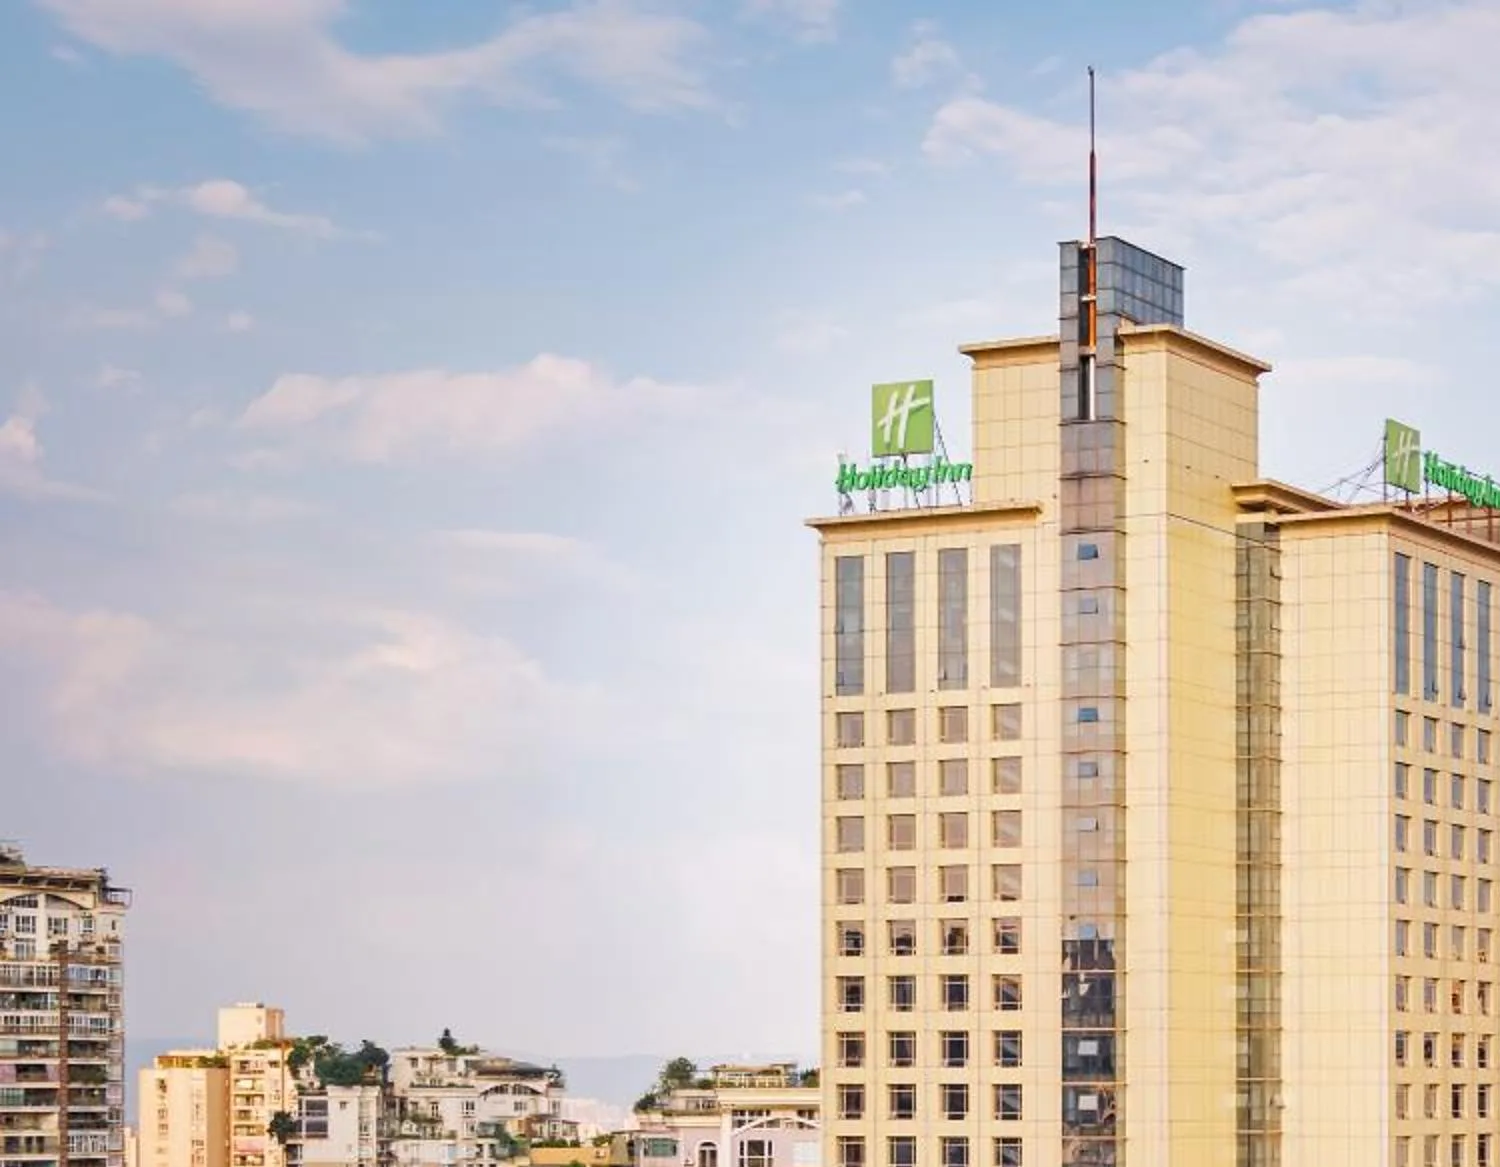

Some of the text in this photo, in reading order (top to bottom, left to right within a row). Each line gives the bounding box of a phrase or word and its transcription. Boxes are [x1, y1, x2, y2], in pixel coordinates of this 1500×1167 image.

[836, 456, 973, 494] Holiday Inn
[1424, 450, 1484, 507] Holiday
